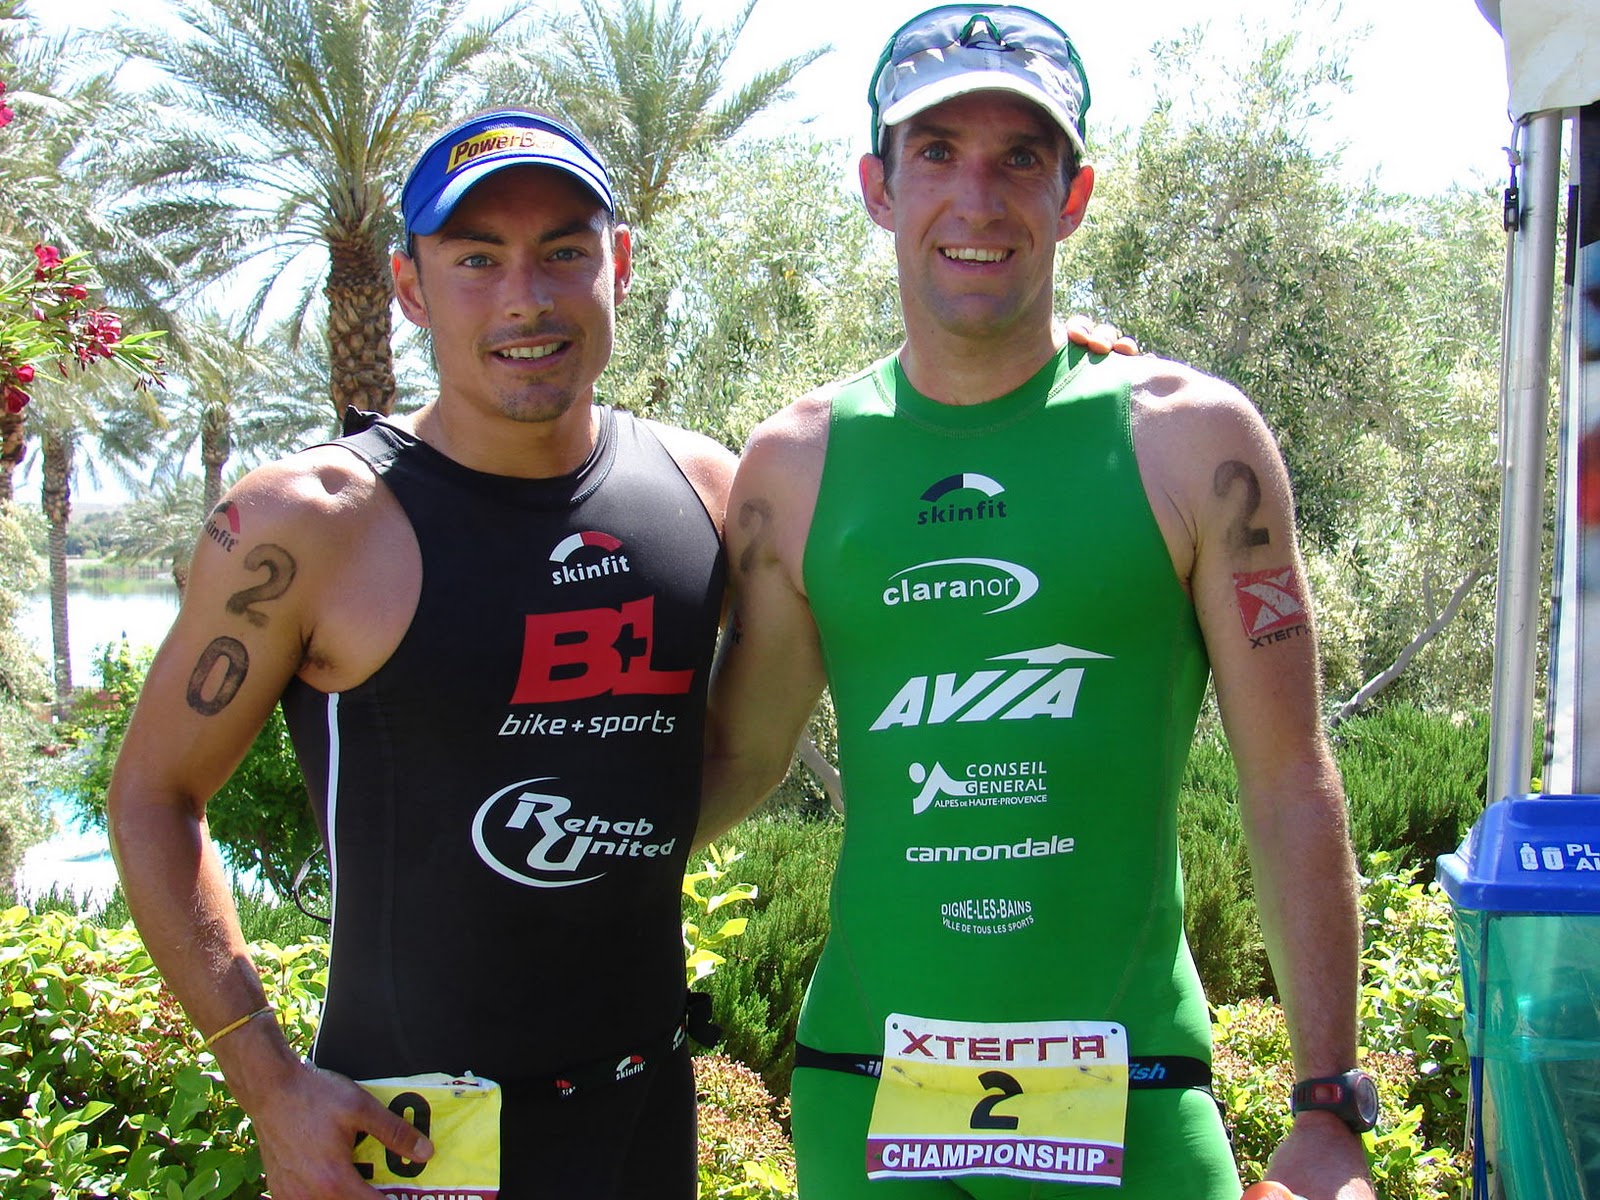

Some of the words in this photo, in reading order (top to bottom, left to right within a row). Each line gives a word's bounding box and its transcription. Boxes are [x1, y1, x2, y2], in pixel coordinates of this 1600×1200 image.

[453, 131, 555, 165] PowerB
[917, 500, 1007, 525] skinfit
[1214, 460, 1269, 550] 2
[552, 555, 630, 585] skinfit
[882, 577, 1014, 606] claranor
[868, 667, 1086, 732] AVIA
[965, 761, 1048, 778] CONSEIL
[965, 778, 1048, 795] GENERAL
[505, 791, 655, 837] Rehab
[934, 799, 960, 808] ALPES
[526, 835, 676, 872] United
[905, 834, 1076, 863] cannondale
[942, 916, 960, 932] VILLE
[961, 923, 971, 933] DE
[973, 925, 992, 935] TOUS
[993, 924, 1007, 935] LES
[1007, 914, 1034, 932] SPORTS
[901, 1028, 1106, 1061] XTERRA
[616, 1062, 646, 1081] skinfit
[969, 1070, 1023, 1130] 2
[881, 1143, 1105, 1172] CHAMPIONSHIP
